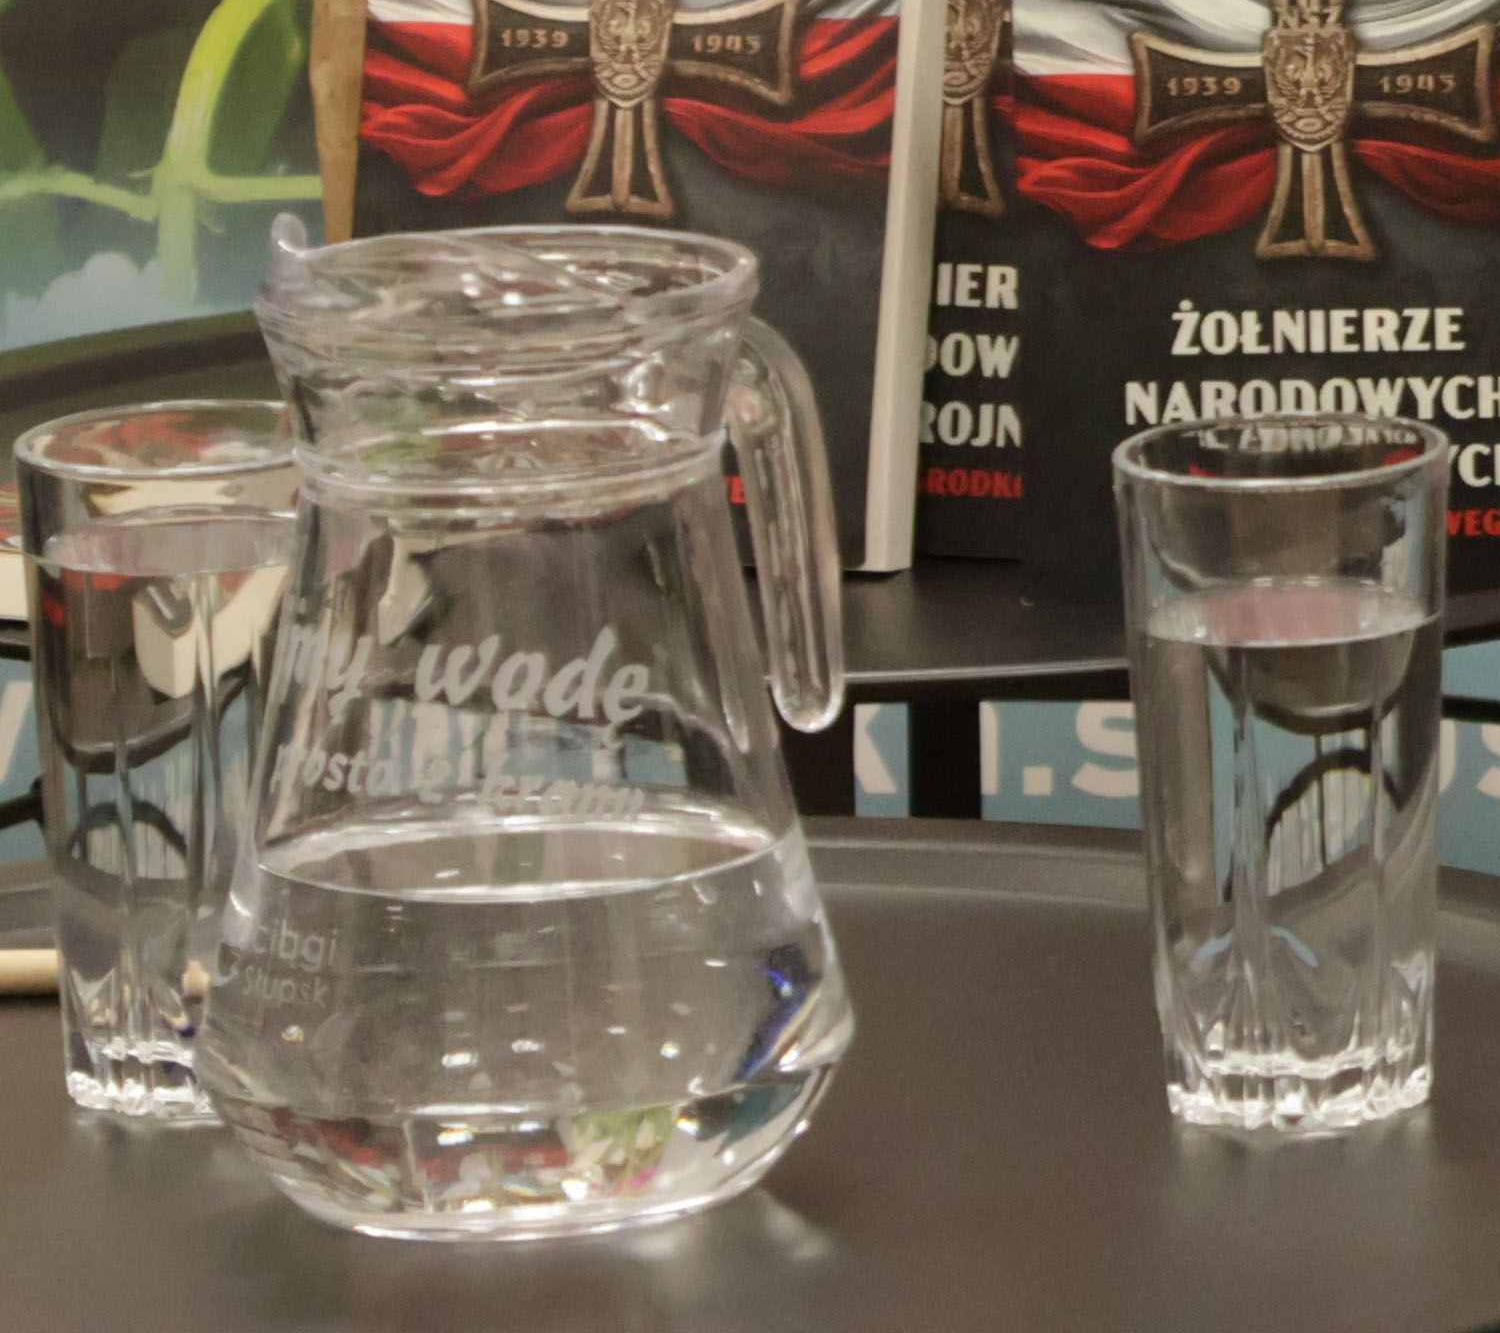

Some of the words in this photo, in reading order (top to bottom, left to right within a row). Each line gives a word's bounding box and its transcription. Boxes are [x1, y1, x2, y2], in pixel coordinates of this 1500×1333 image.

[501, 28, 569, 50] 1939
[1166, 74, 1243, 97] 1939
[936, 262, 1019, 310] IER
[1170, 298, 1466, 356] ŻOŁNIERZE
